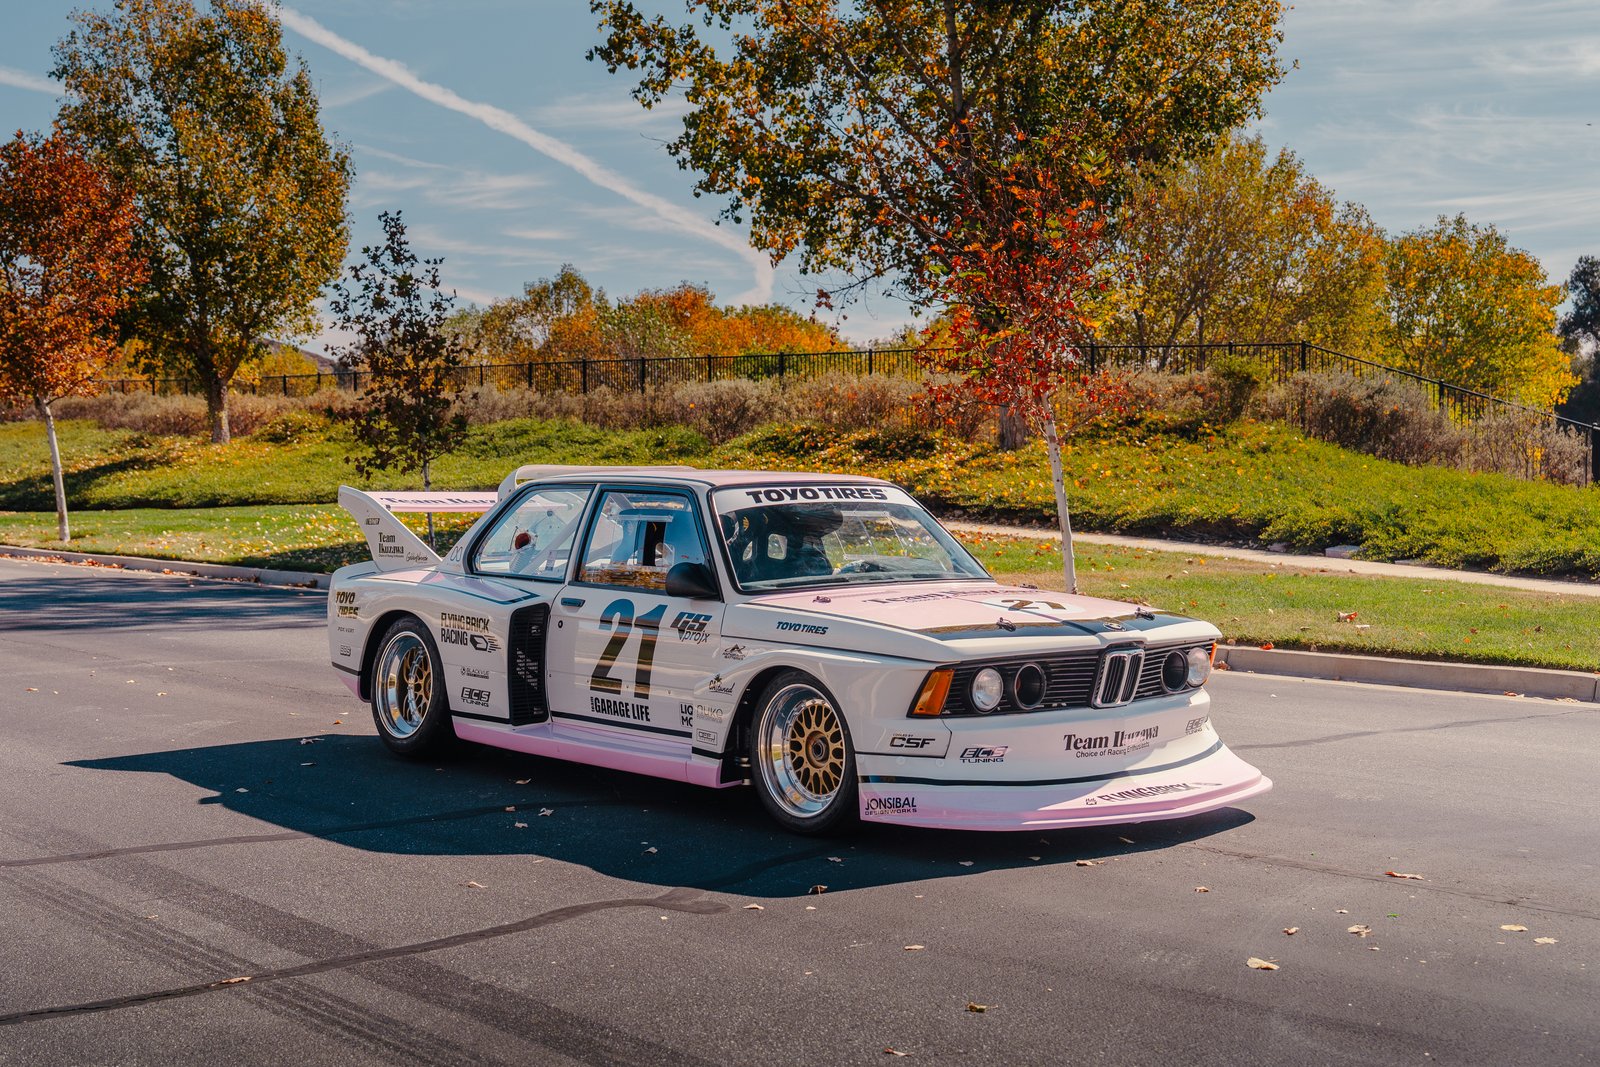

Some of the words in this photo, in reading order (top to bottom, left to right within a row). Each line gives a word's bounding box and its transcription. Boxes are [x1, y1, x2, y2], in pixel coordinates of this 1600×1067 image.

[378, 532, 395, 542] Team
[336, 591, 356, 604] TOYO
[441, 628, 468, 645] RACING
[682, 630, 710, 644] projx
[590, 598, 668, 700] 21
[461, 687, 491, 702] ECS
[594, 697, 630, 718] GARAGE
[631, 703, 651, 722] LIFE
[889, 736, 936, 748] CSF
[1063, 732, 1109, 751] Team
[959, 746, 1009, 759] ECS
[1075, 750, 1099, 758] Choice
[1100, 748, 1107, 756] of
[865, 797, 918, 810] JONSIBAL
